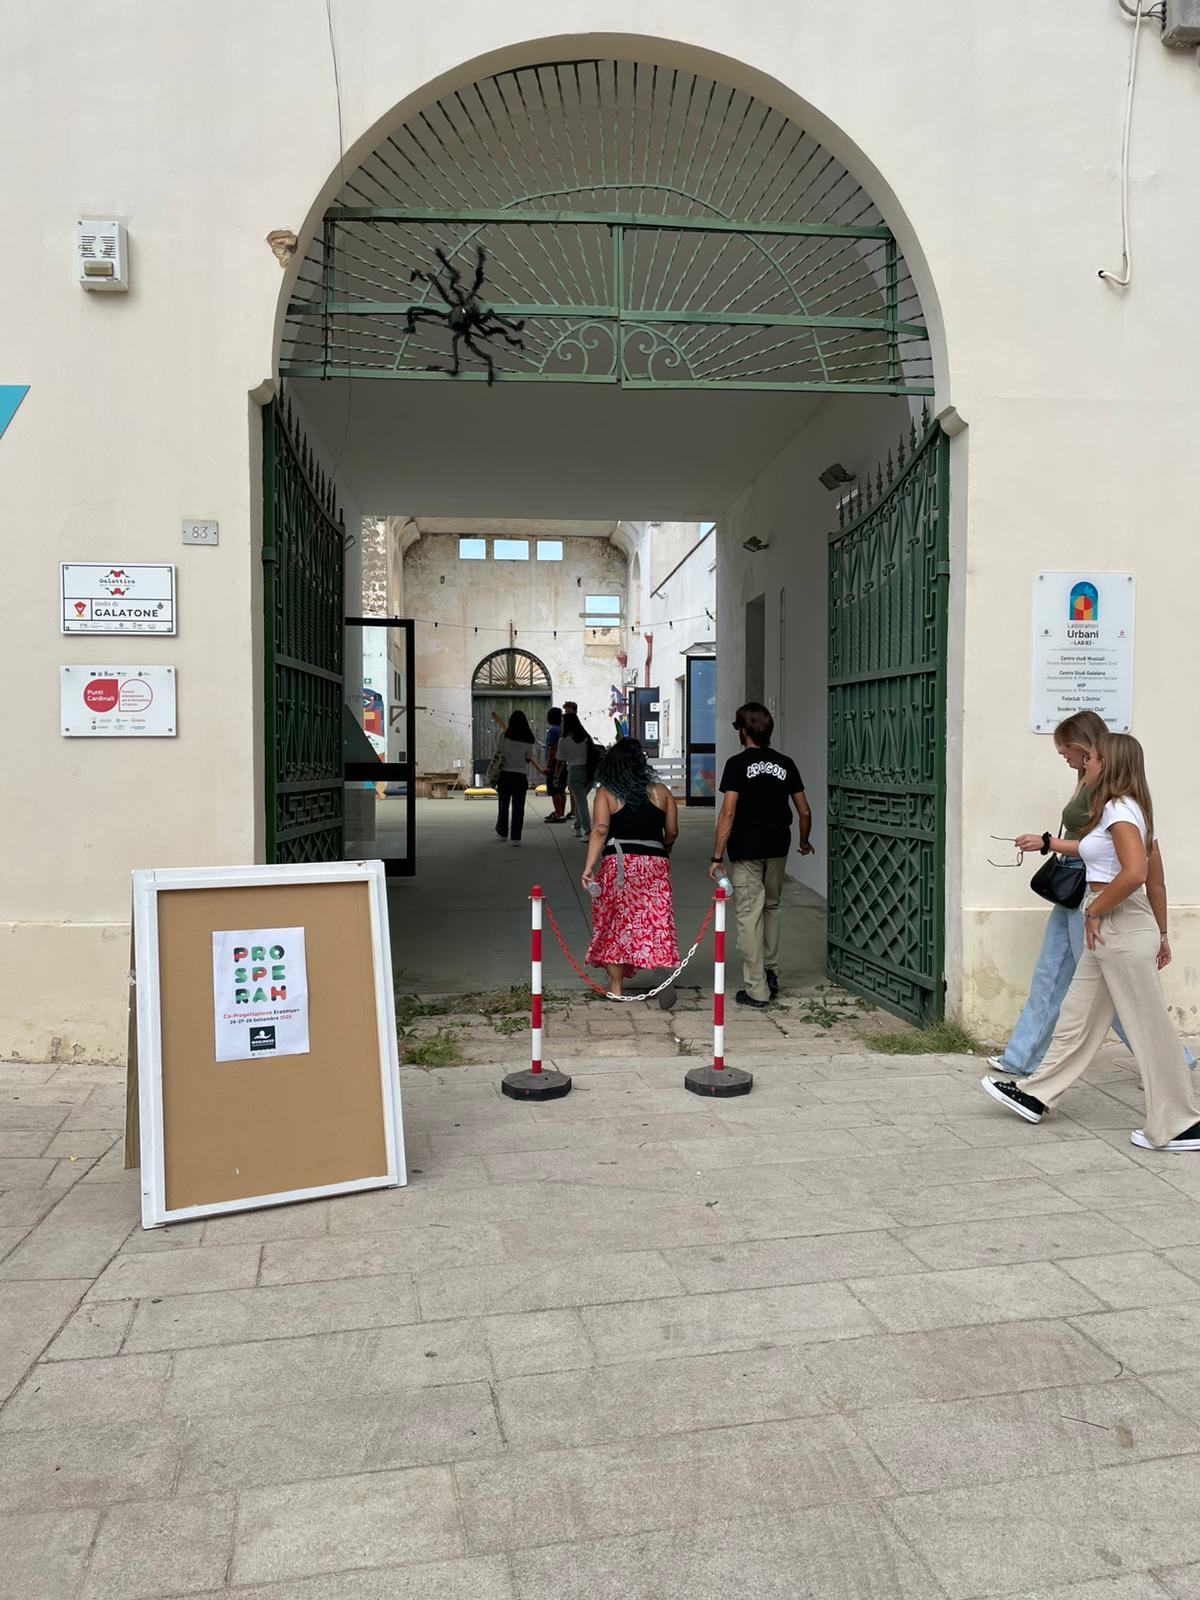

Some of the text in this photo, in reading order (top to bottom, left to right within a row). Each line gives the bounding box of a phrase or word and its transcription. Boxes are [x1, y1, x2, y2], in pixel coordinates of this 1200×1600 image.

[192, 526, 208, 539] 83
[95, 609, 159, 617] GALATONE
[1067, 630, 1099, 638] Urbani
[234, 945, 285, 963] PRO
[235, 965, 286, 984] SPE
